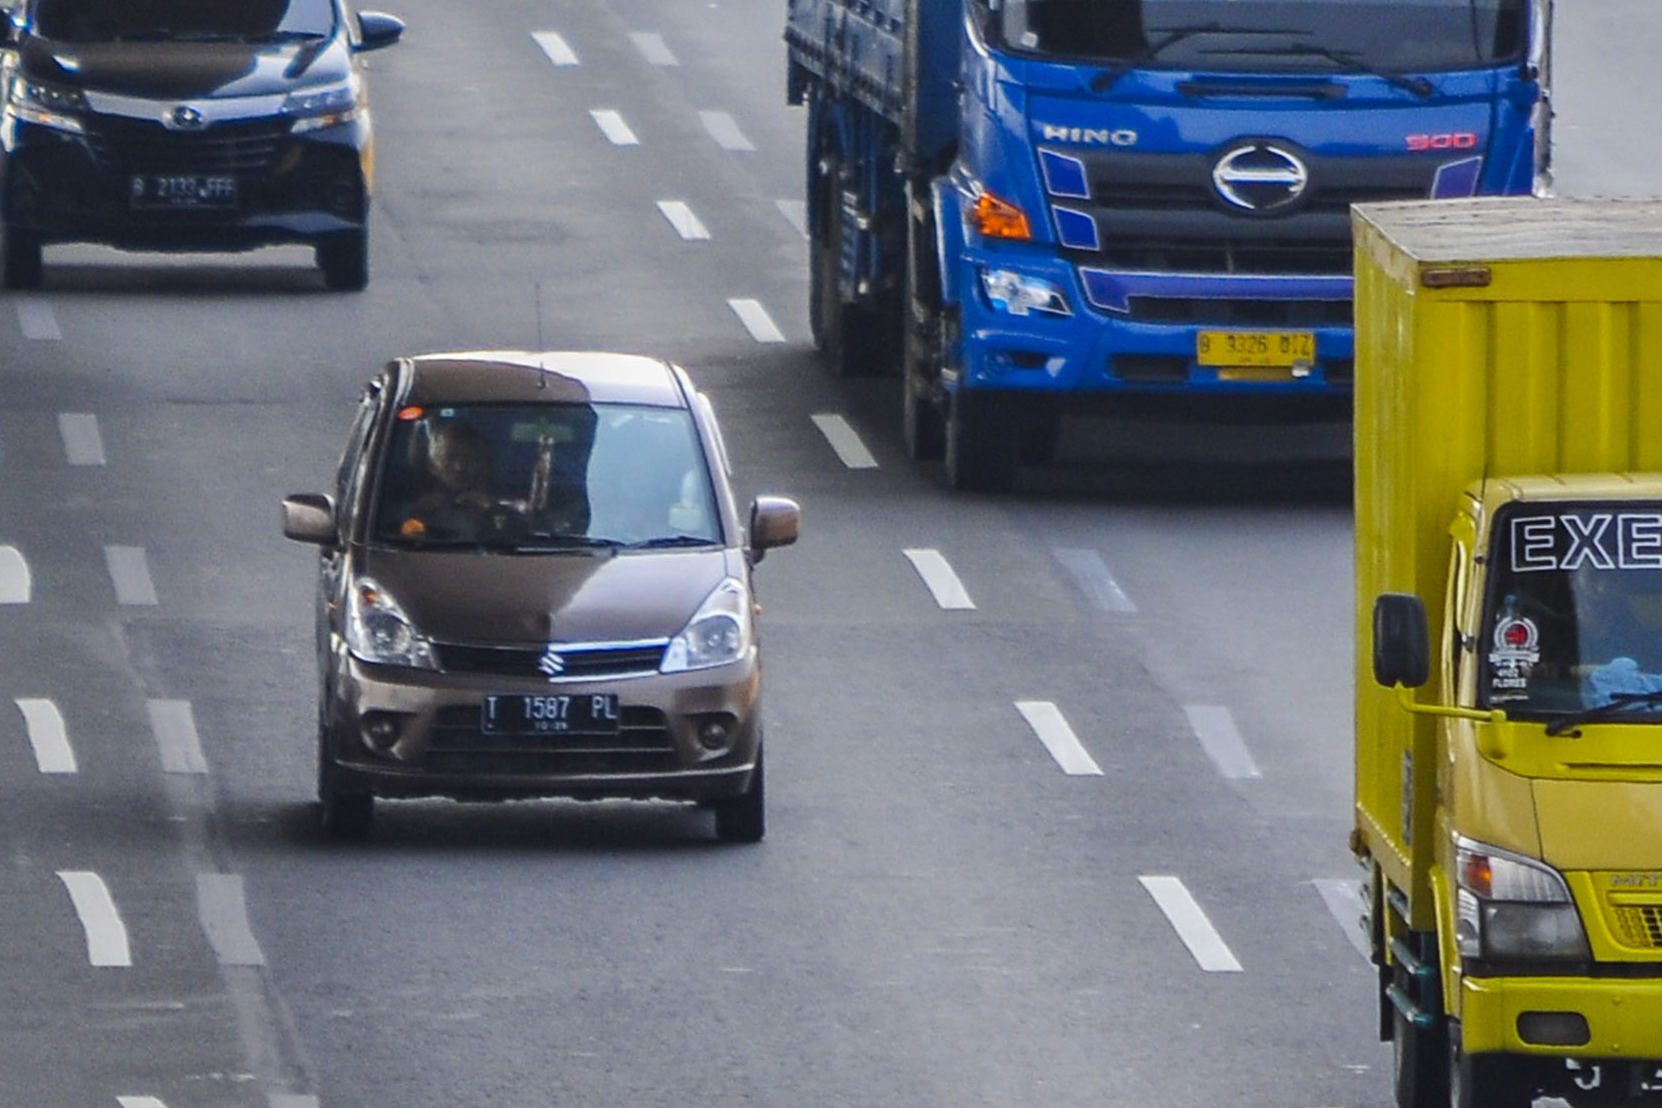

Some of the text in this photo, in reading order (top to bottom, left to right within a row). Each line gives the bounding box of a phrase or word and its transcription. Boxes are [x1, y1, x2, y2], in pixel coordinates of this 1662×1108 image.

[1043, 125, 1138, 146] HINO
[1405, 134, 1476, 151] 500
[1511, 514, 1662, 572] EXE
[488, 696, 617, 719] T 1587 PL
